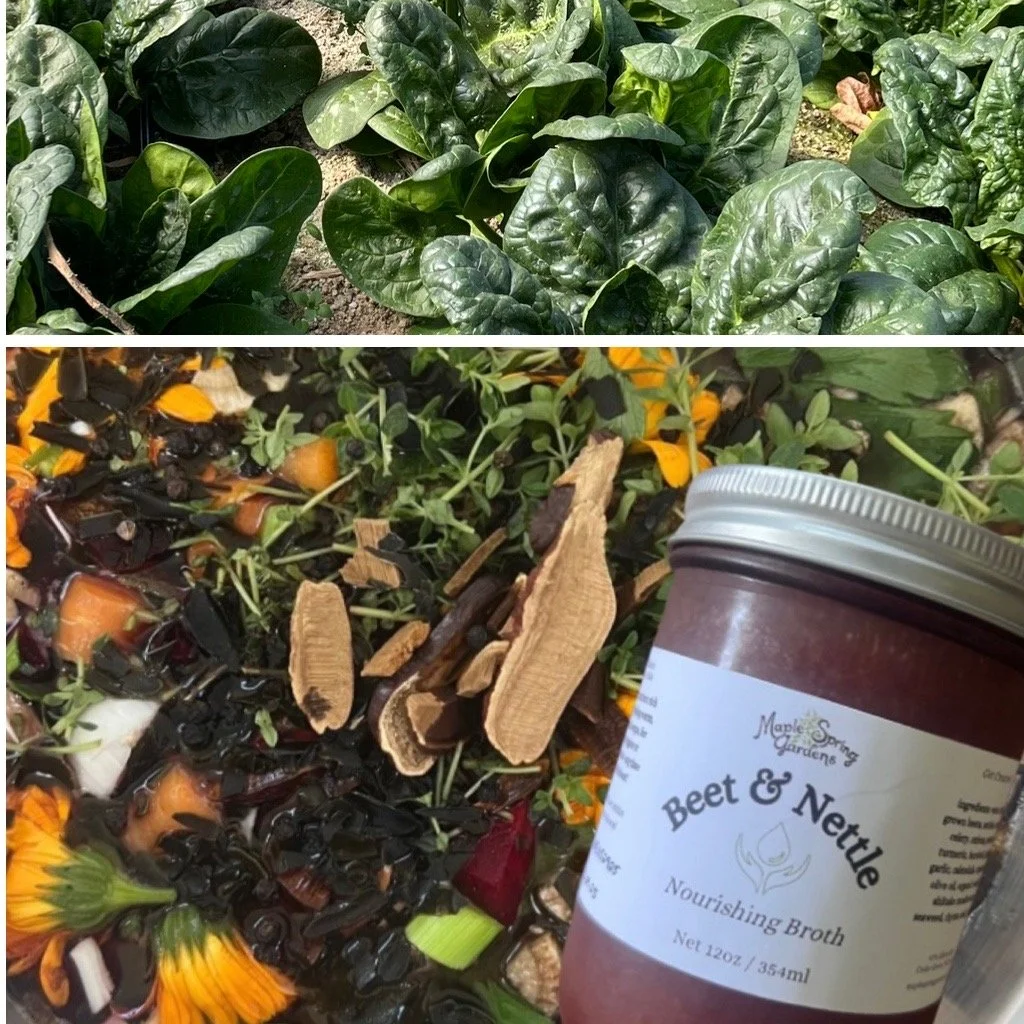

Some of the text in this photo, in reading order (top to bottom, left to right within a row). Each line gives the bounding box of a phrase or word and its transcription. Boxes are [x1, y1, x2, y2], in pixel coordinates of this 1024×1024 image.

[753, 711, 859, 767] Maple Spring
[774, 735, 836, 767] Gardens
[661, 774, 739, 832] Beet
[749, 768, 792, 805] &
[792, 783, 884, 891] Nettle
[664, 876, 846, 948] Nourishing Broth
[672, 929, 702, 953] Net
[705, 944, 743, 968] 12oz
[757, 961, 812, 985] 354ml
